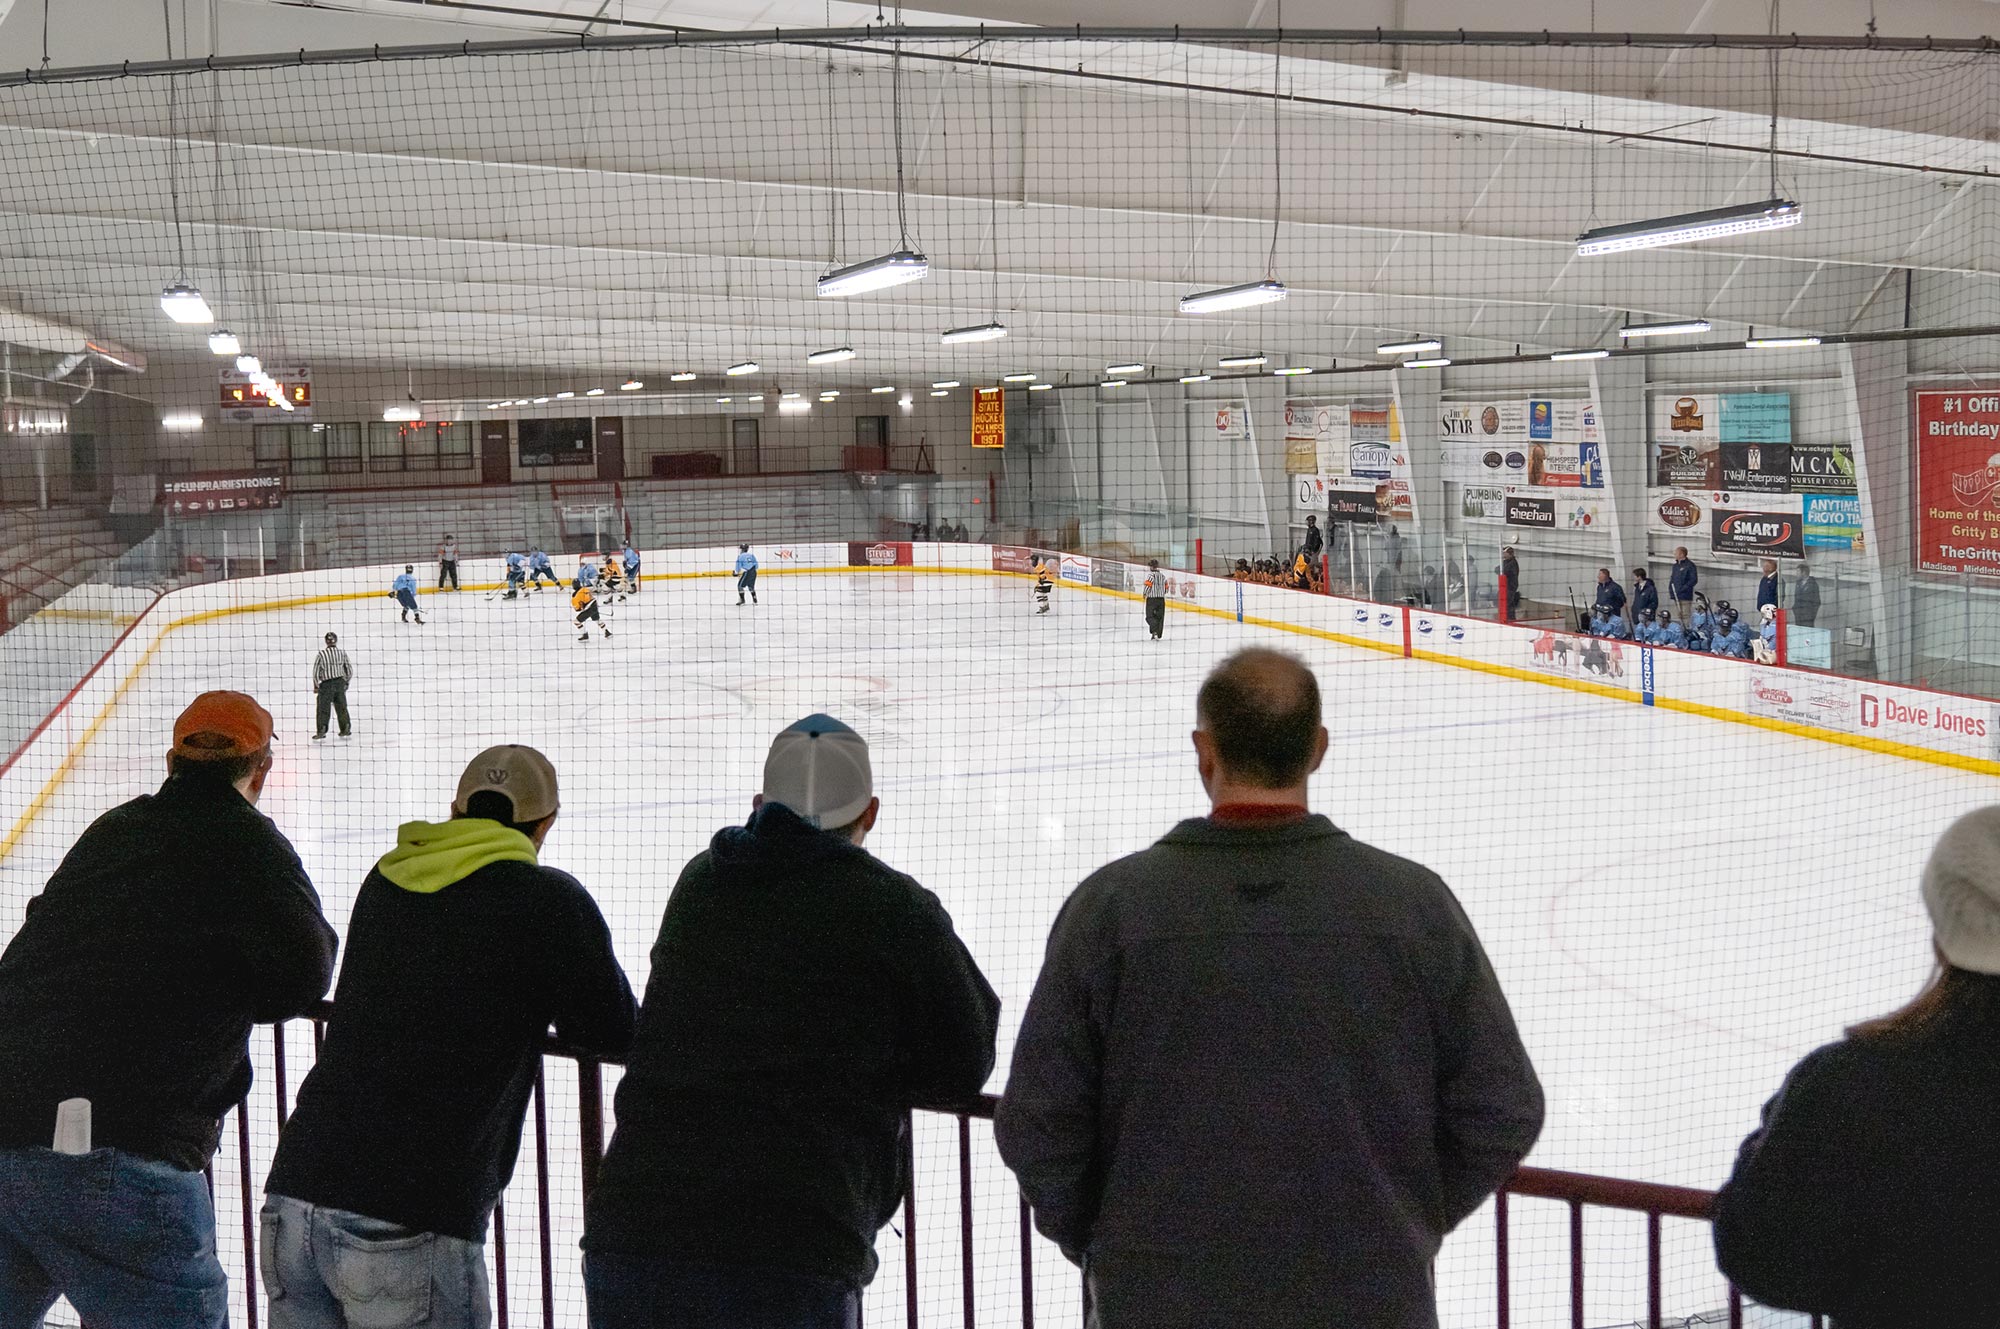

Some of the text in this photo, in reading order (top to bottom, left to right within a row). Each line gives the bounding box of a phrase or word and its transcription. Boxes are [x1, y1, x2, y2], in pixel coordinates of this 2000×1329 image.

[978, 401, 1000, 412] STATE
[1943, 397, 1999, 413] #1 Offi
[975, 412, 1003, 423] HOCKEY
[1449, 409, 1461, 418] THE
[975, 423, 1003, 434] CHAMPS
[1442, 414, 1473, 437] STAR
[1929, 420, 2000, 440] Birthday
[980, 434, 998, 445] 1997
[1352, 447, 1390, 467] Canopy
[1747, 471, 1787, 486] Enterprises
[1790, 476, 1826, 485] NURSERY
[1465, 488, 1503, 501] PLUMBING
[1330, 503, 1339, 512] THE
[1357, 503, 1376, 514] FAMILY
[1661, 505, 1690, 516] Eddie's
[1810, 499, 1860, 512] ANYTIME
[1510, 507, 1552, 521] Sheehan
[1808, 510, 1844, 523] FROYO
[1929, 507, 2000, 522] Home of the
[1733, 520, 1780, 537] SMART
[1952, 525, 1987, 541] Gritty
[1733, 535, 1758, 543] MOTORS
[868, 549, 896, 559] STEVENS
[1747, 547, 1764, 555] Toyota
[1922, 561, 1957, 572] Madison
[1643, 647, 1654, 694] Reebok
[1762, 693, 1789, 703] UTILITY
[1805, 712, 1822, 721] VALUE
[1886, 697, 1929, 727] Dave
[1934, 706, 1986, 737] Jones
